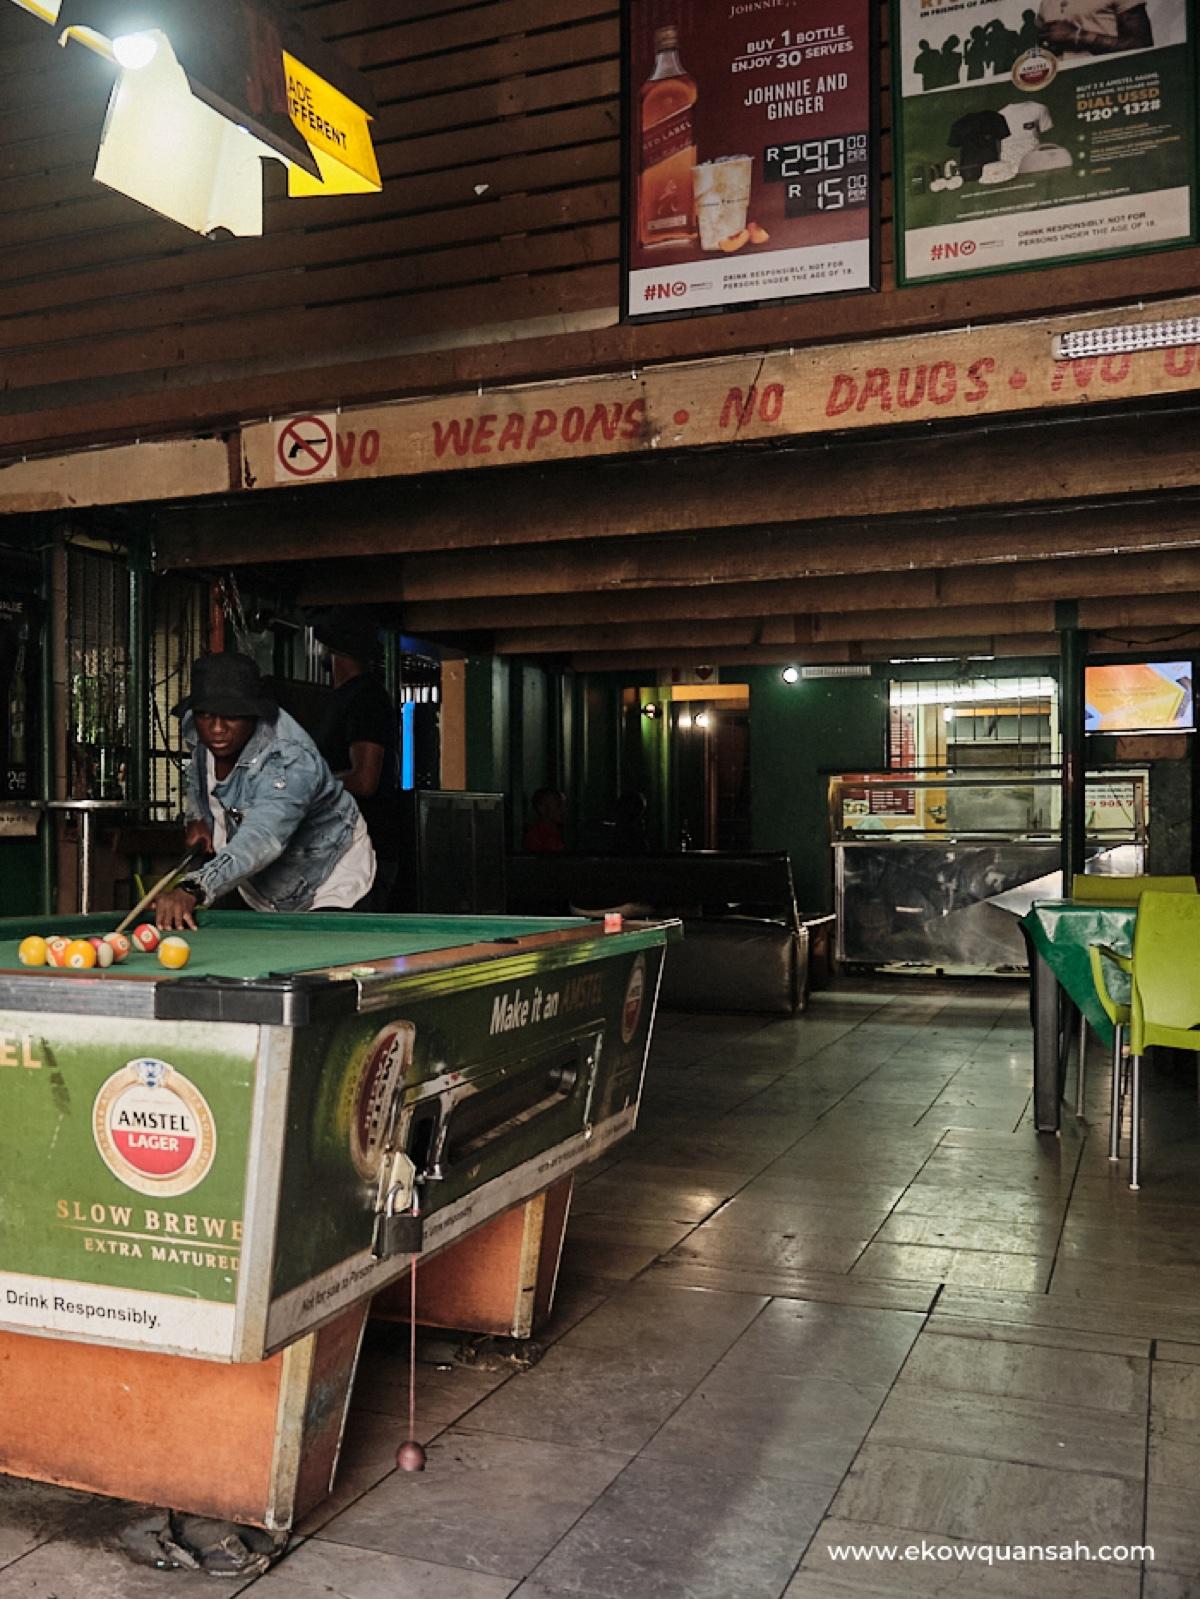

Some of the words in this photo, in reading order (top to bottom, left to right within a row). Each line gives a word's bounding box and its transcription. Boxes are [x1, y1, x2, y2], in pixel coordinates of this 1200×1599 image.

[747, 38, 775, 54] BUY
[781, 30, 791, 46] 1
[796, 25, 846, 44] BOTTLE
[731, 56, 773, 73] ENJOY
[776, 51, 802, 69] 30
[805, 40, 854, 59] SERVES
[289, 76, 314, 109] ADE
[744, 78, 812, 106] JOHNNIE
[816, 73, 848, 94] AND
[1076, 96, 1113, 111] DIAL
[1117, 88, 1160, 104] USSD
[290, 97, 347, 151] IFFERENT
[767, 96, 824, 121] GINGER
[662, 120, 693, 140] LABEL
[767, 148, 780, 162] R
[781, 138, 845, 177] 290
[846, 134, 867, 150] 00
[788, 184, 802, 198] R
[817, 178, 845, 210] 15
[847, 174, 867, 189] 00
[1092, 227, 1108, 236] THE
[1127, 211, 1146, 220] FOR
[431, 397, 647, 459] WEAPONS
[719, 381, 785, 429] NO
[826, 356, 996, 418] DRUGS
[489, 988, 529, 1036] Make
[530, 986, 543, 1024] it
[543, 991, 560, 1020] an
[118, 1110, 190, 1132] AMSTEL
[128, 1133, 179, 1152] LAGER
[56, 1199, 133, 1227] SLOW
[144, 1209, 243, 1240] BREWE
[84, 1237, 143, 1259] EXTRA
[6, 1289, 49, 1310] Drink
[54, 1297, 161, 1329] Responsibly.
